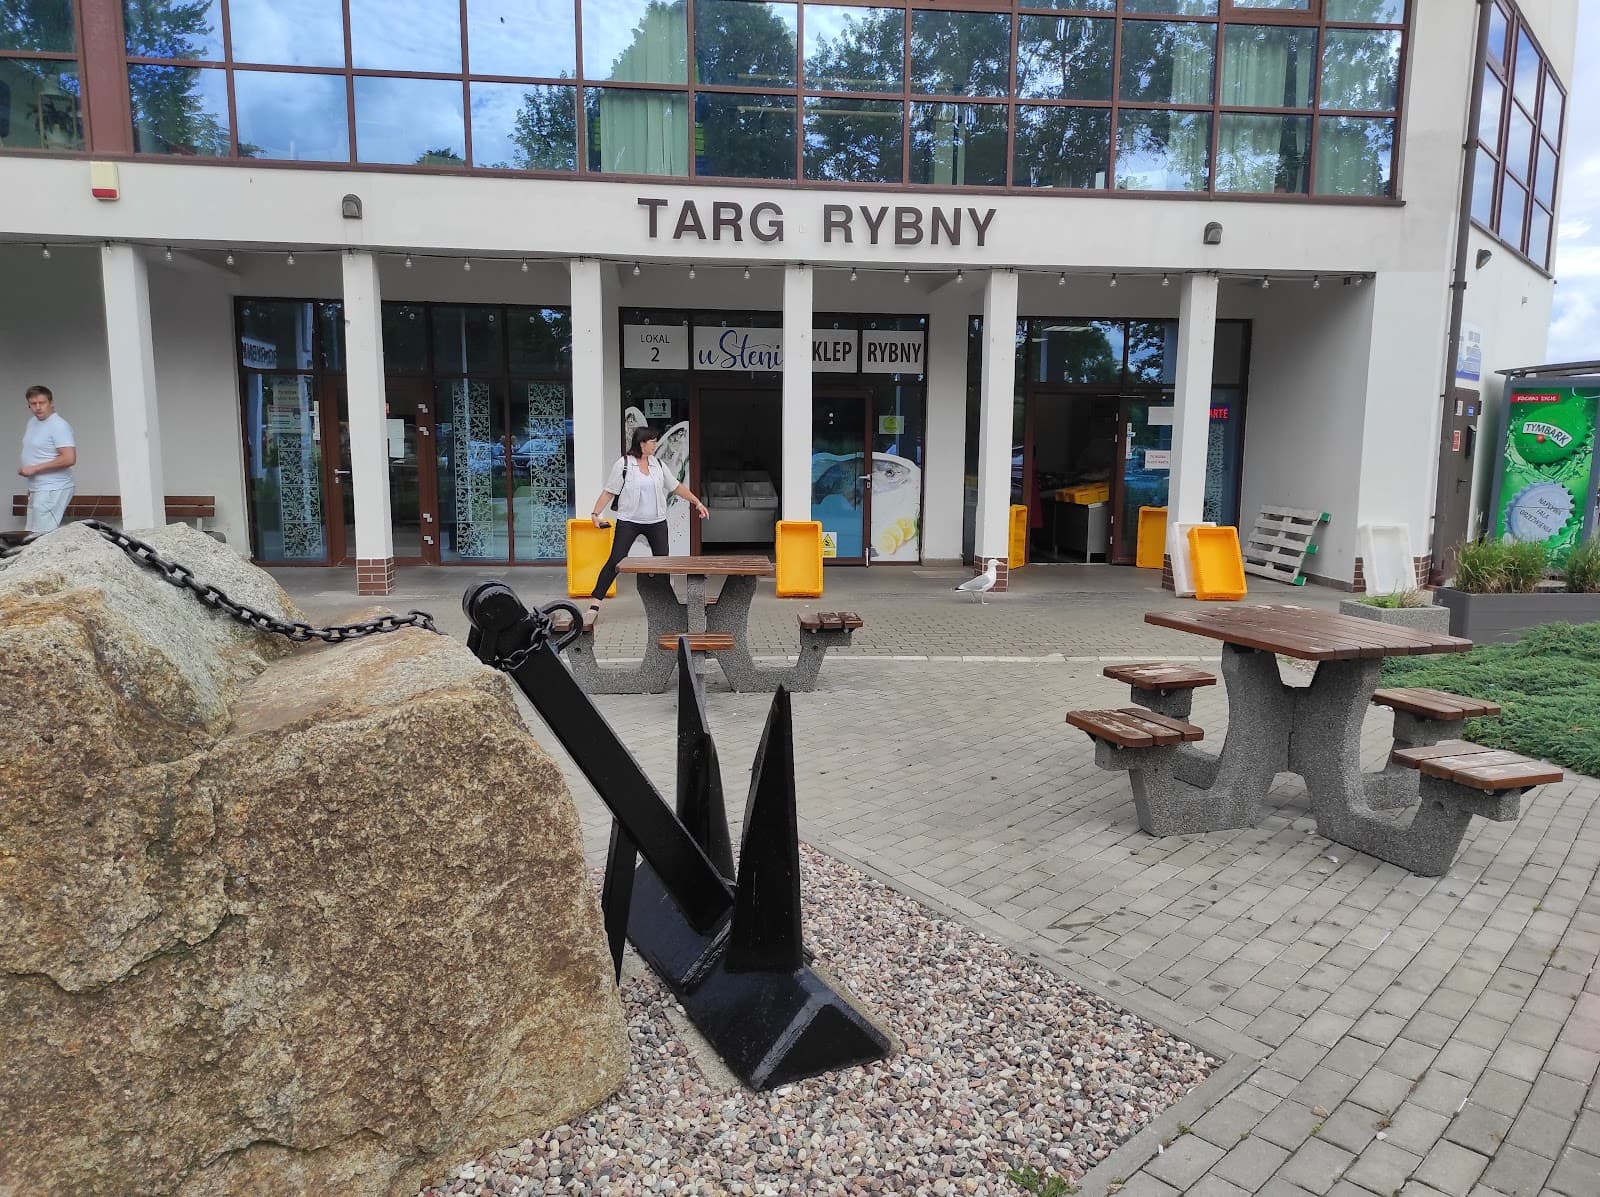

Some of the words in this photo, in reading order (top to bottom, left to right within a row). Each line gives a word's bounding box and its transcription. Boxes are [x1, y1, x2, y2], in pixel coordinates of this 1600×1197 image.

[637, 197, 785, 243] TARG
[823, 203, 998, 247] RYBNY
[640, 333, 671, 345] LOKAL
[719, 329, 783, 370] Steni
[650, 346, 660, 362] 2
[812, 341, 853, 362] KLEP
[867, 341, 922, 363] RYBNY
[1209, 408, 1229, 419] ARTE
[1525, 422, 1570, 446] TYMBARK
